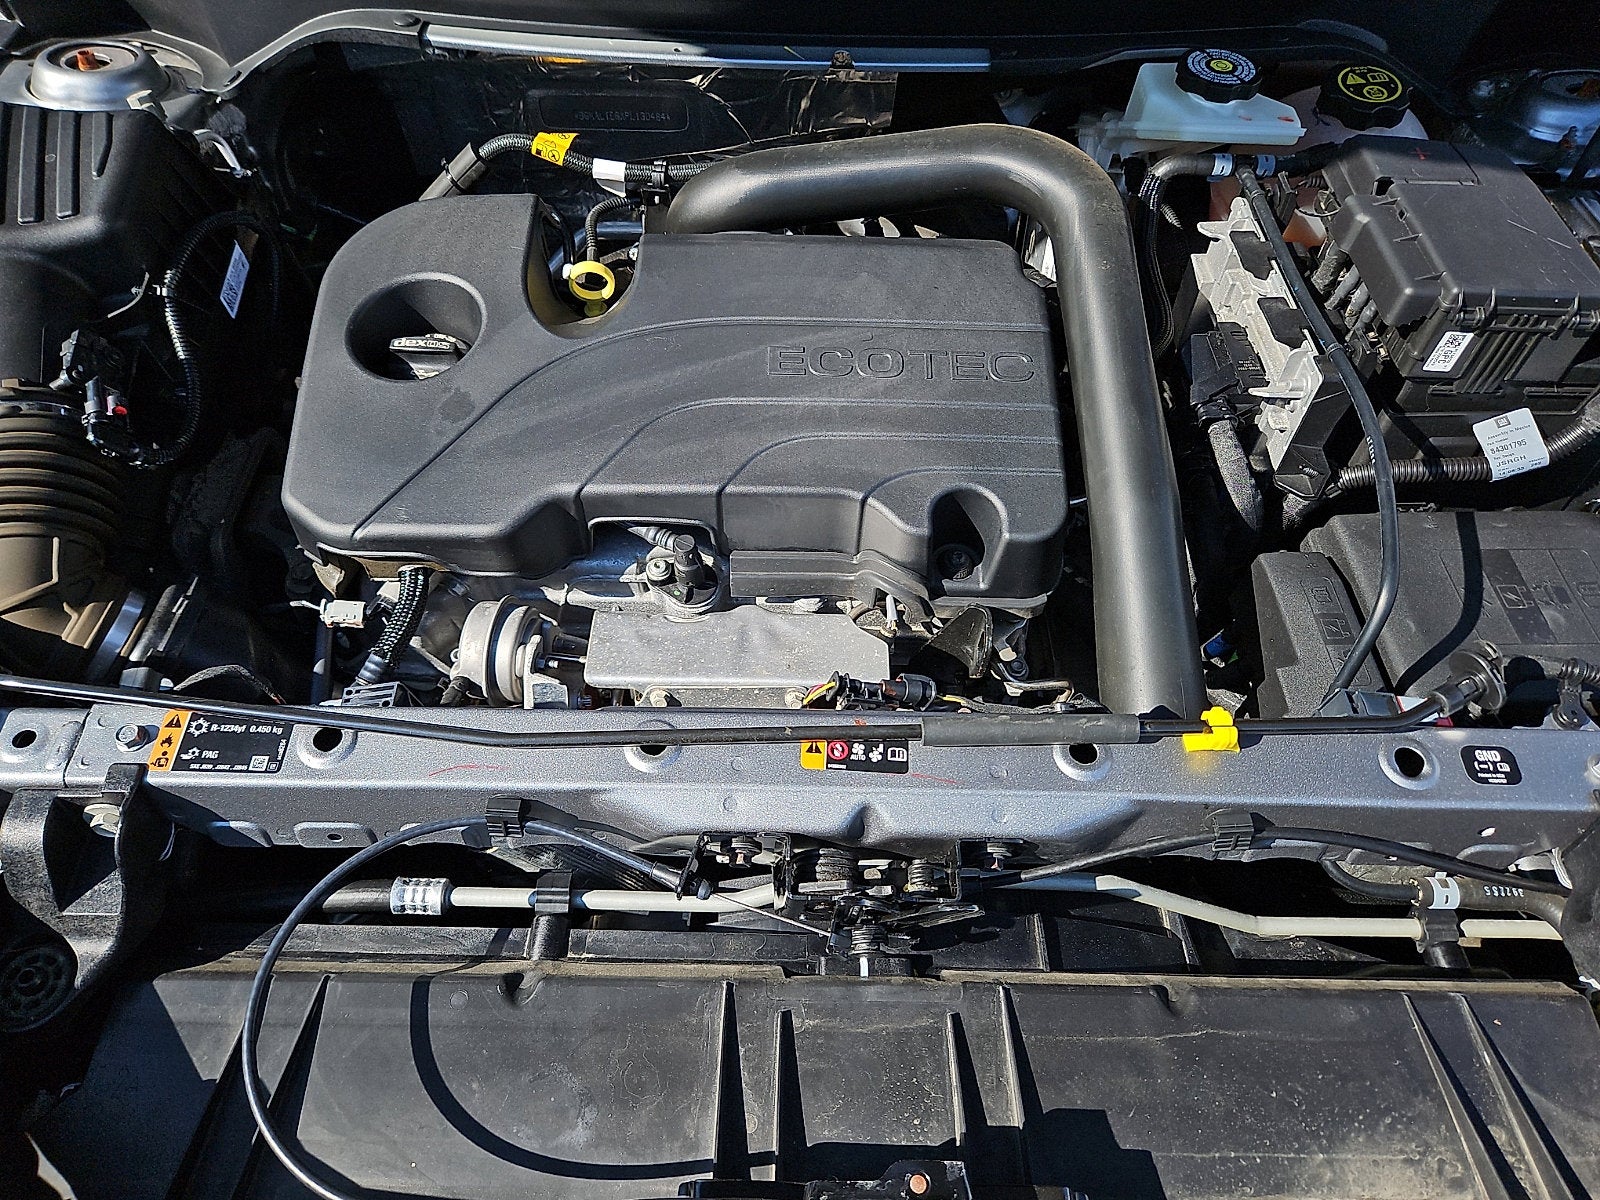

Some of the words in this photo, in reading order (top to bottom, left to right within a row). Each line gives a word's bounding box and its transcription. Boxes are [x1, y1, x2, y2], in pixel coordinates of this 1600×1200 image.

[393, 338, 450, 350] dexos
[767, 346, 1035, 383] ECOTEC
[1489, 438, 1527, 455] 84301795
[210, 724, 247, 734] R-1234yf
[249, 725, 272, 734] 0.450
[272, 725, 284, 735] kg
[201, 750, 220, 759] PAG
[1474, 749, 1502, 762] GND
